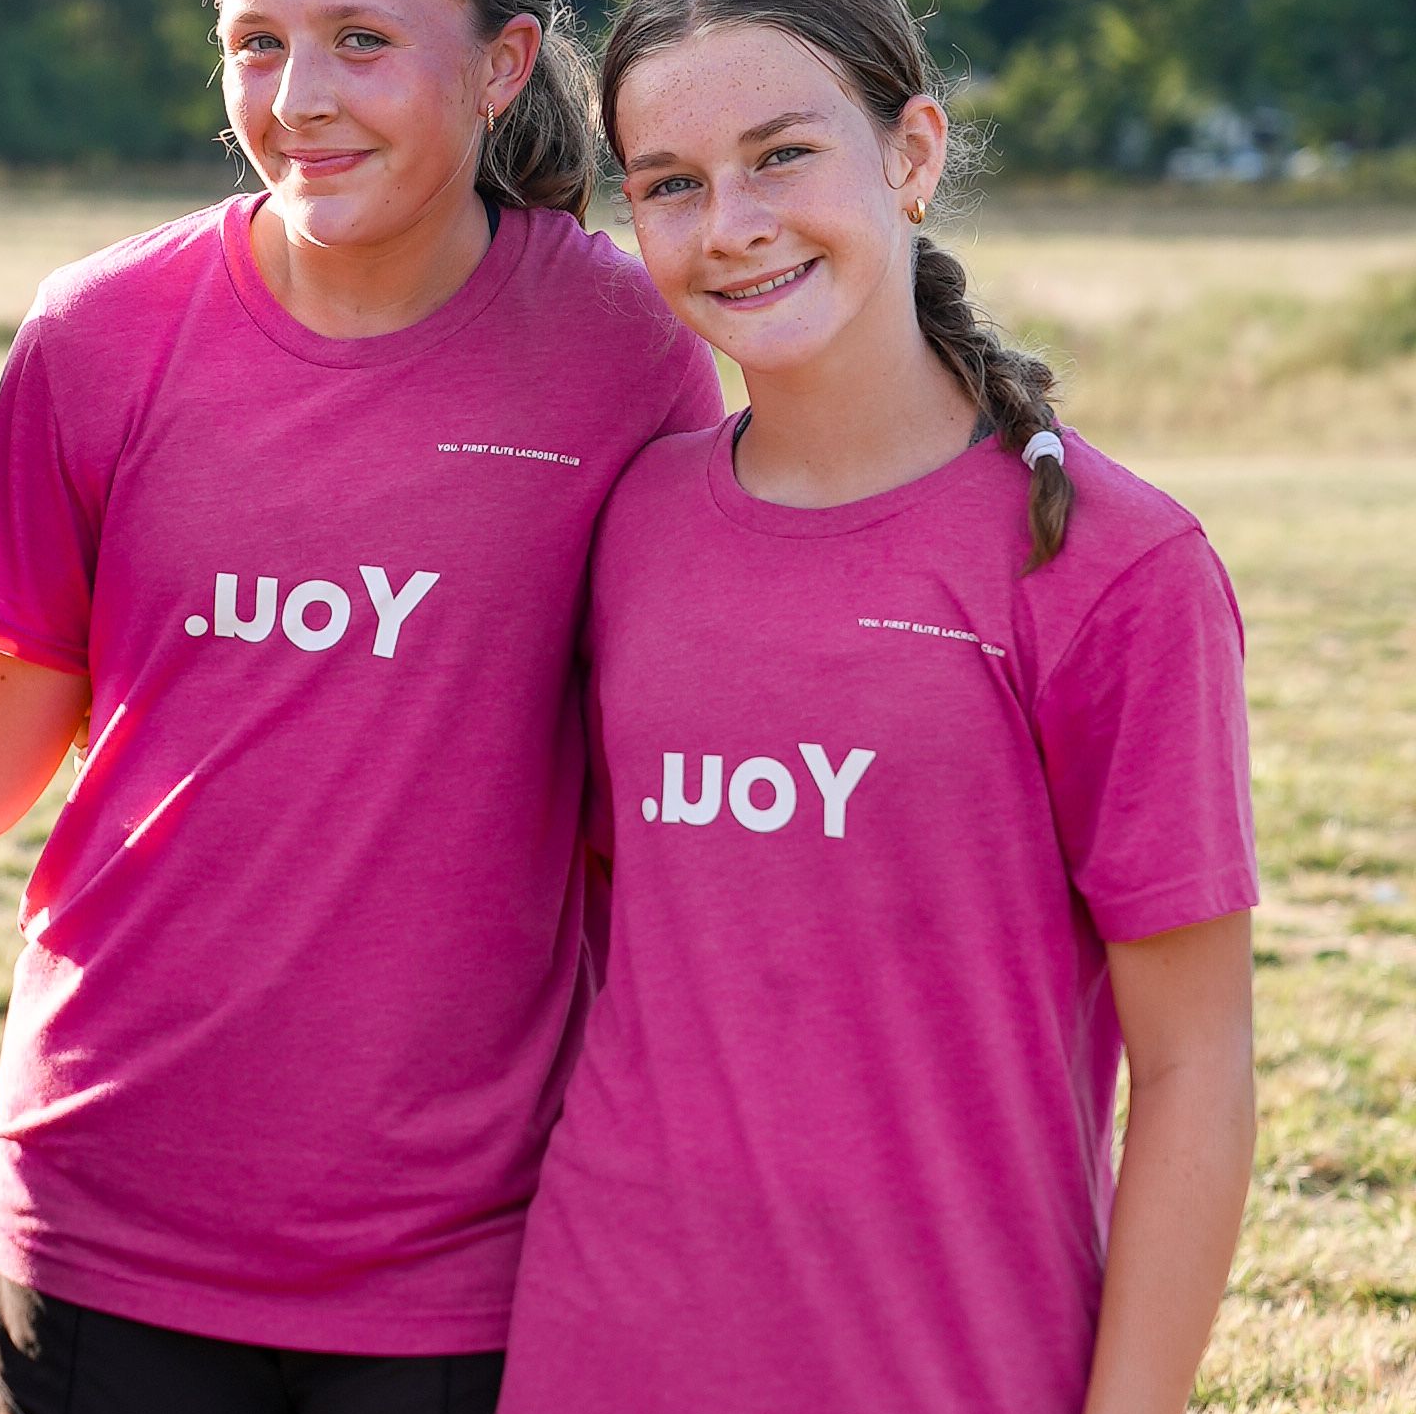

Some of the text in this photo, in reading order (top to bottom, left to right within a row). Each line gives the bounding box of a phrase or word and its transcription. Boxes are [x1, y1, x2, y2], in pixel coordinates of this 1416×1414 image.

[437, 443, 580, 466] YOU. FIRST ELITE LACROSSE CLUB
[883, 619, 911, 630] FIRST
[912, 623, 939, 636] ELITE
[941, 628, 979, 643] LACRO
